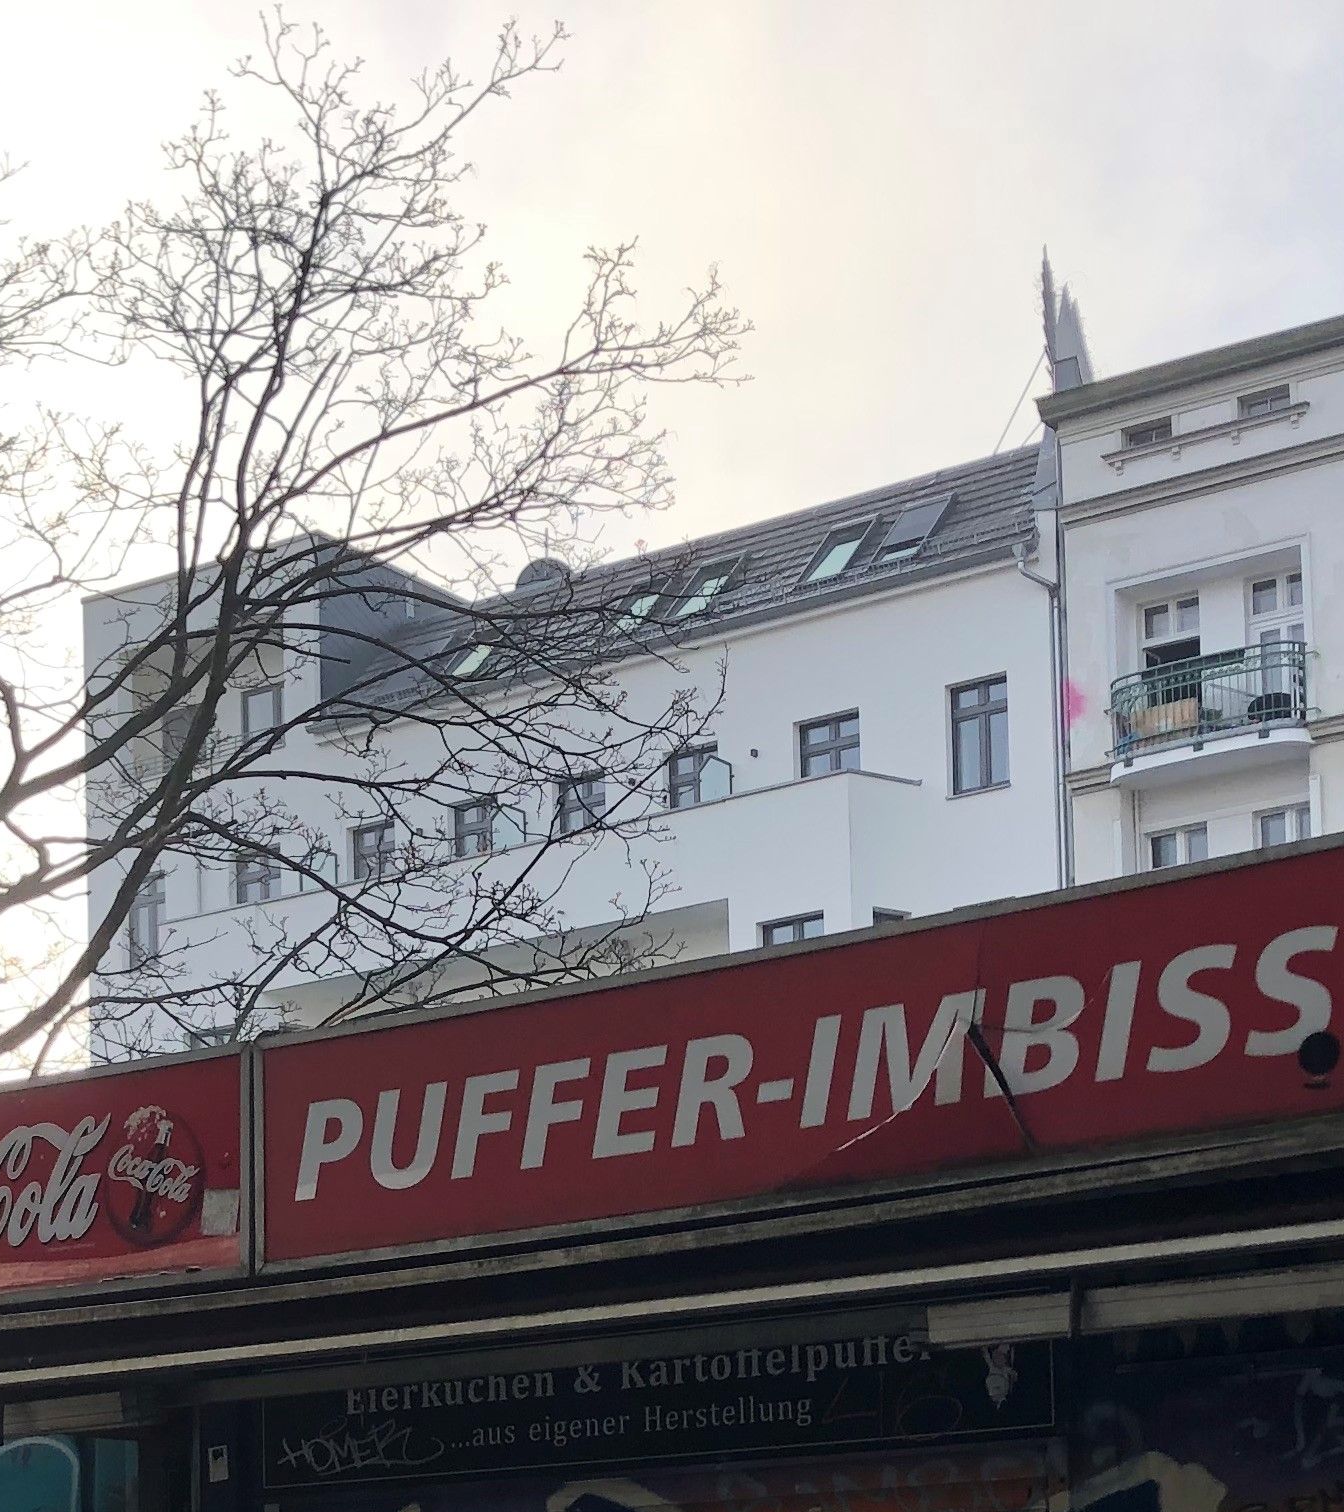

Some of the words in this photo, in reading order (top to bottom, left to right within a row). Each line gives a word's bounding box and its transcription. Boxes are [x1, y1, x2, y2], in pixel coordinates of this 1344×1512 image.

[295, 925, 1339, 1202] PUFFER-IMBISS
[108, 1144, 200, 1203] Coca-Cola
[573, 1362, 602, 1393] &
[529, 1412, 631, 1448] eigener
[644, 1396, 812, 1433] Herstellung
